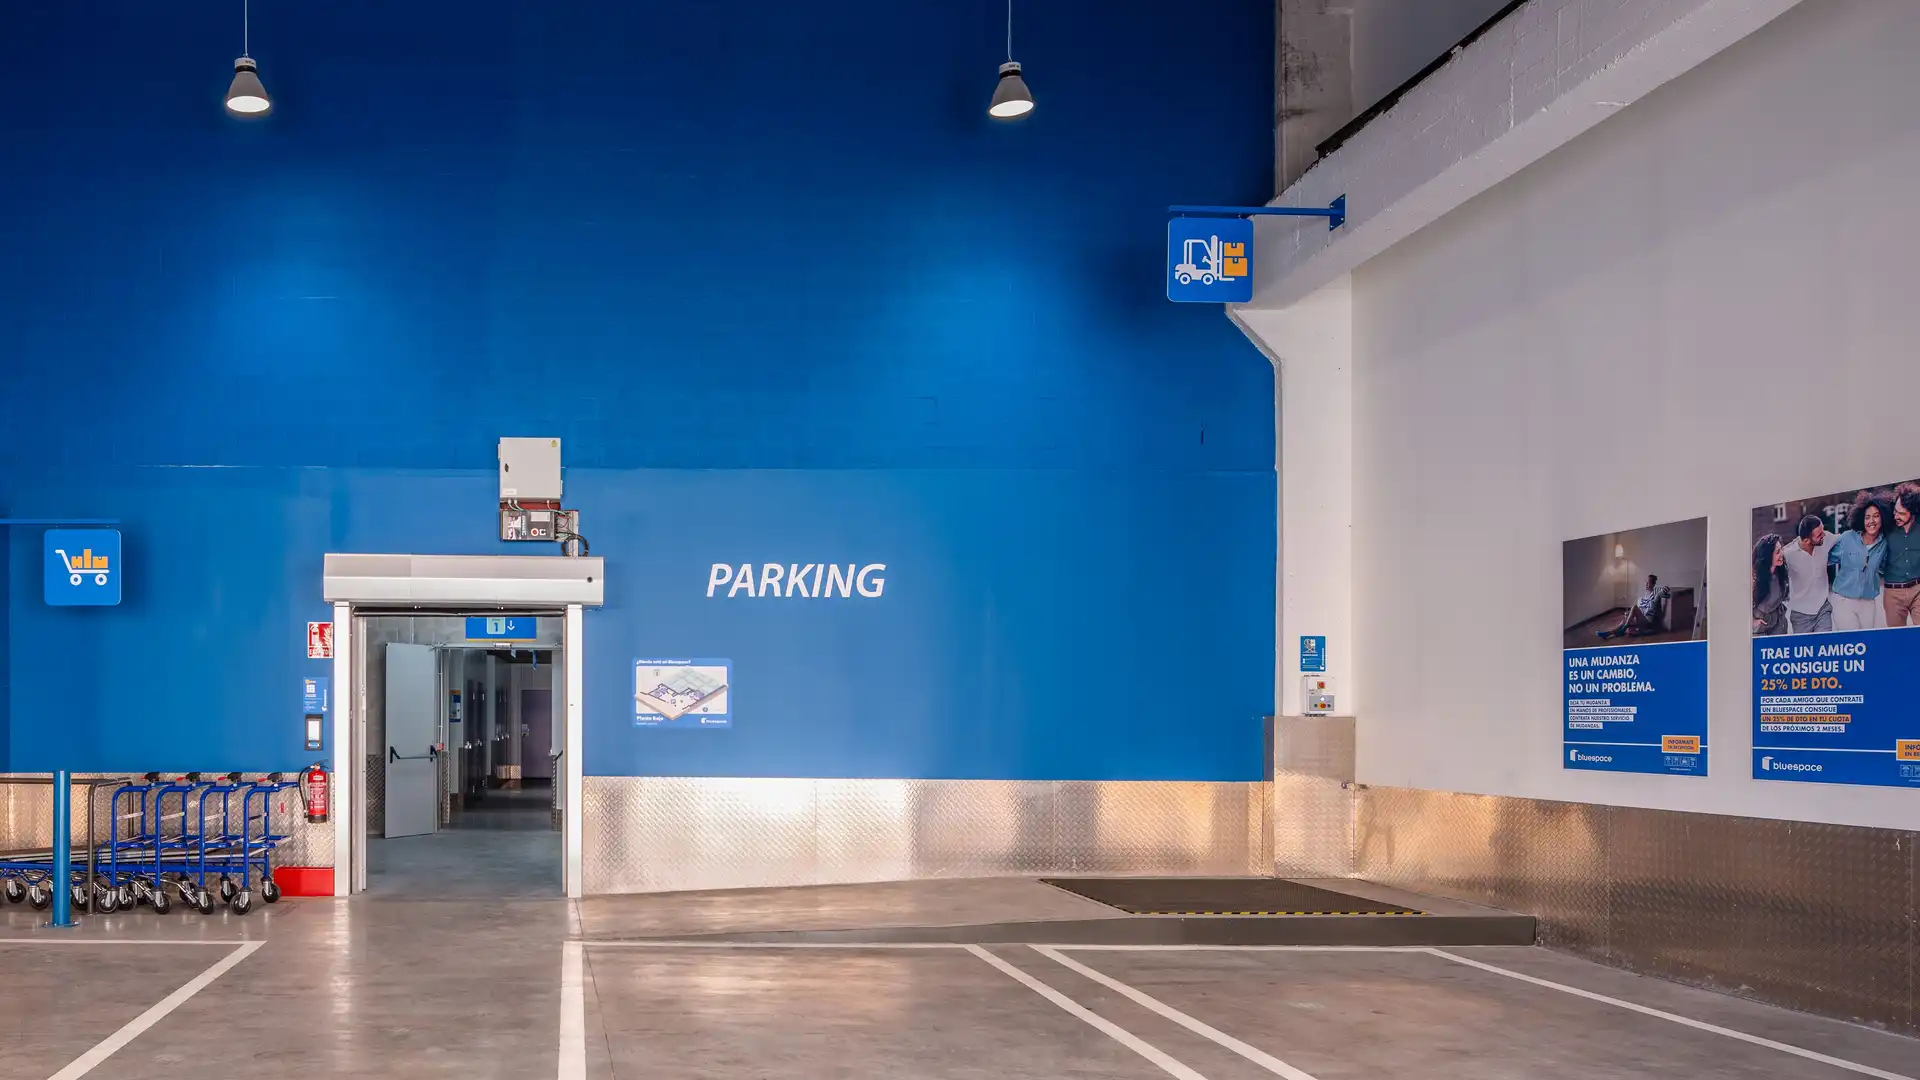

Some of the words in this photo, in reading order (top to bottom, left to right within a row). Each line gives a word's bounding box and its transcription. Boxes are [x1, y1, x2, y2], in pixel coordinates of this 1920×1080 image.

[706, 563, 886, 598] PARKING
[494, 622, 498, 632] 1
[1761, 647, 1790, 659] TRAE
[1794, 645, 1813, 658] UN
[1818, 642, 1867, 657] AMIGO
[1569, 657, 1588, 668] UNA
[1591, 655, 1640, 667] MUDANZA
[1760, 663, 1770, 675] Y
[1773, 661, 1839, 675] CONSIGUE
[1844, 659, 1865, 672] UN
[1569, 670, 1578, 680] ES
[1581, 670, 1594, 680] UN
[1597, 668, 1637, 680] CAMBIO,
[1569, 683, 1583, 693] NO
[1585, 682, 1600, 693] UN
[1602, 681, 1655, 693] PROBLEMA.
[1761, 678, 1788, 690] 25%
[1791, 678, 1807, 690] DE
[1811, 676, 1842, 689] DTO.
[1578, 753, 1612, 763] bluespace
[1773, 762, 1823, 772] bluespace
